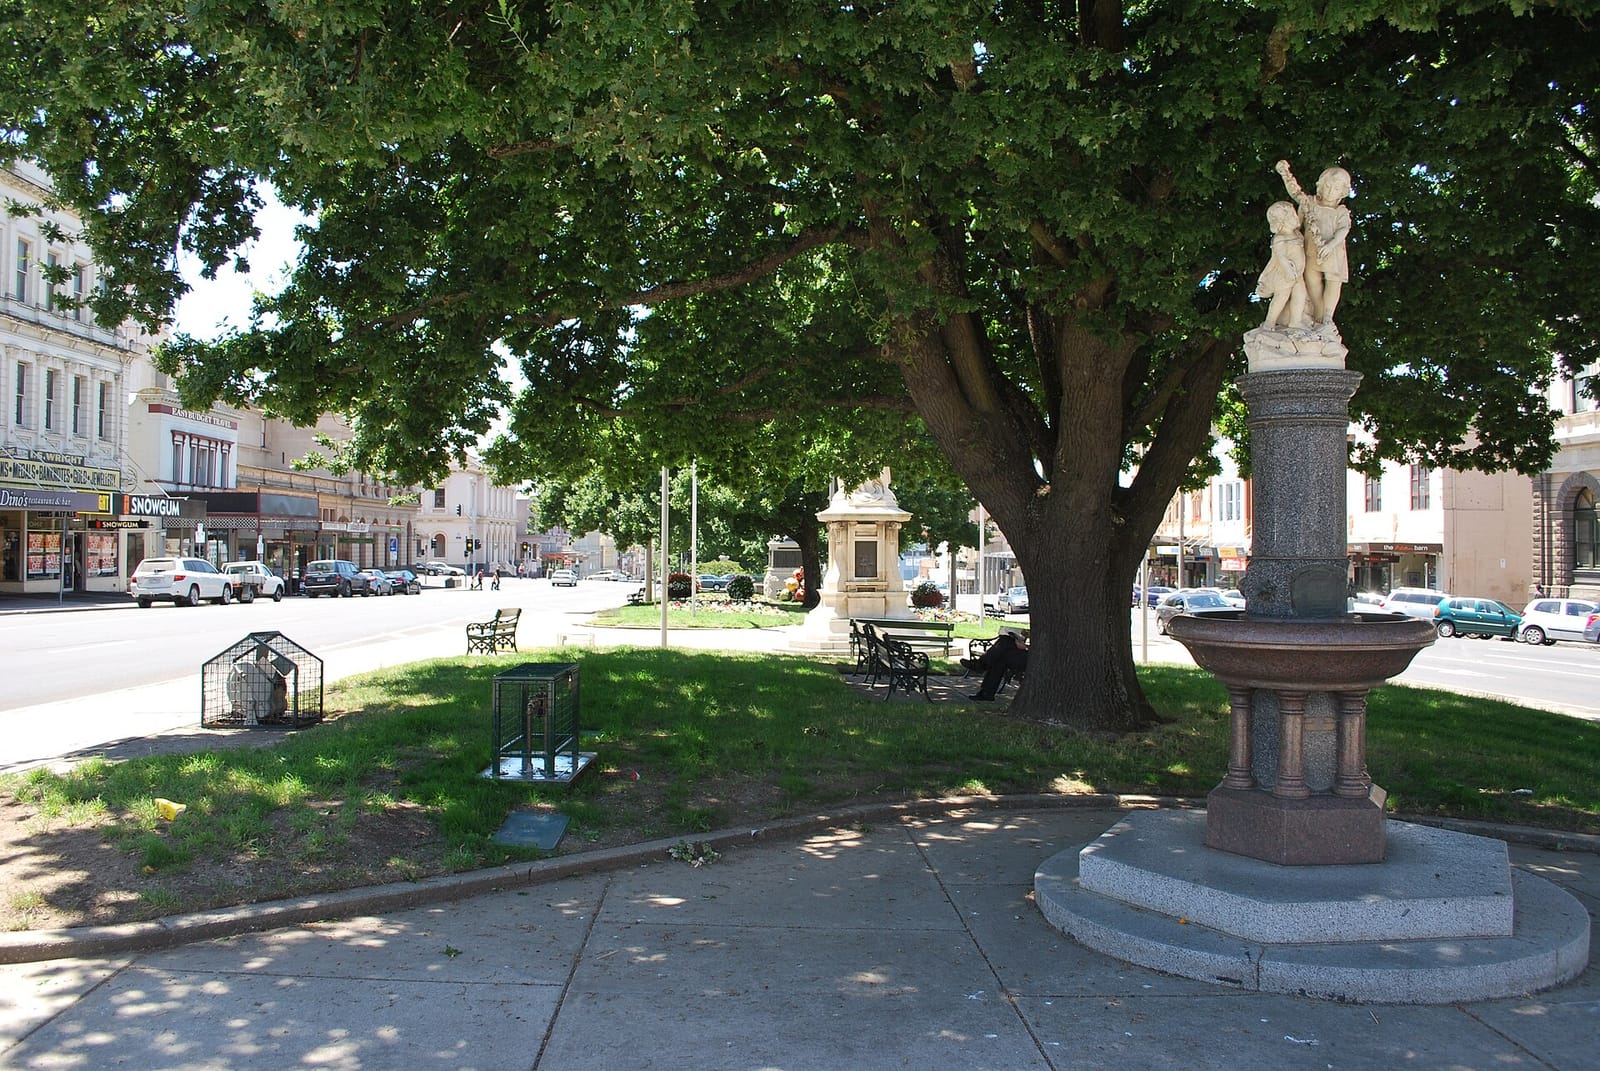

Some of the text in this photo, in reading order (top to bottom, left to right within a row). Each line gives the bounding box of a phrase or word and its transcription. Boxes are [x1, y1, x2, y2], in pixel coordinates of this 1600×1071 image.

[0, 490, 28, 507] Dino's
[61, 496, 72, 505] bar
[131, 496, 180, 516] SNOWGUM
